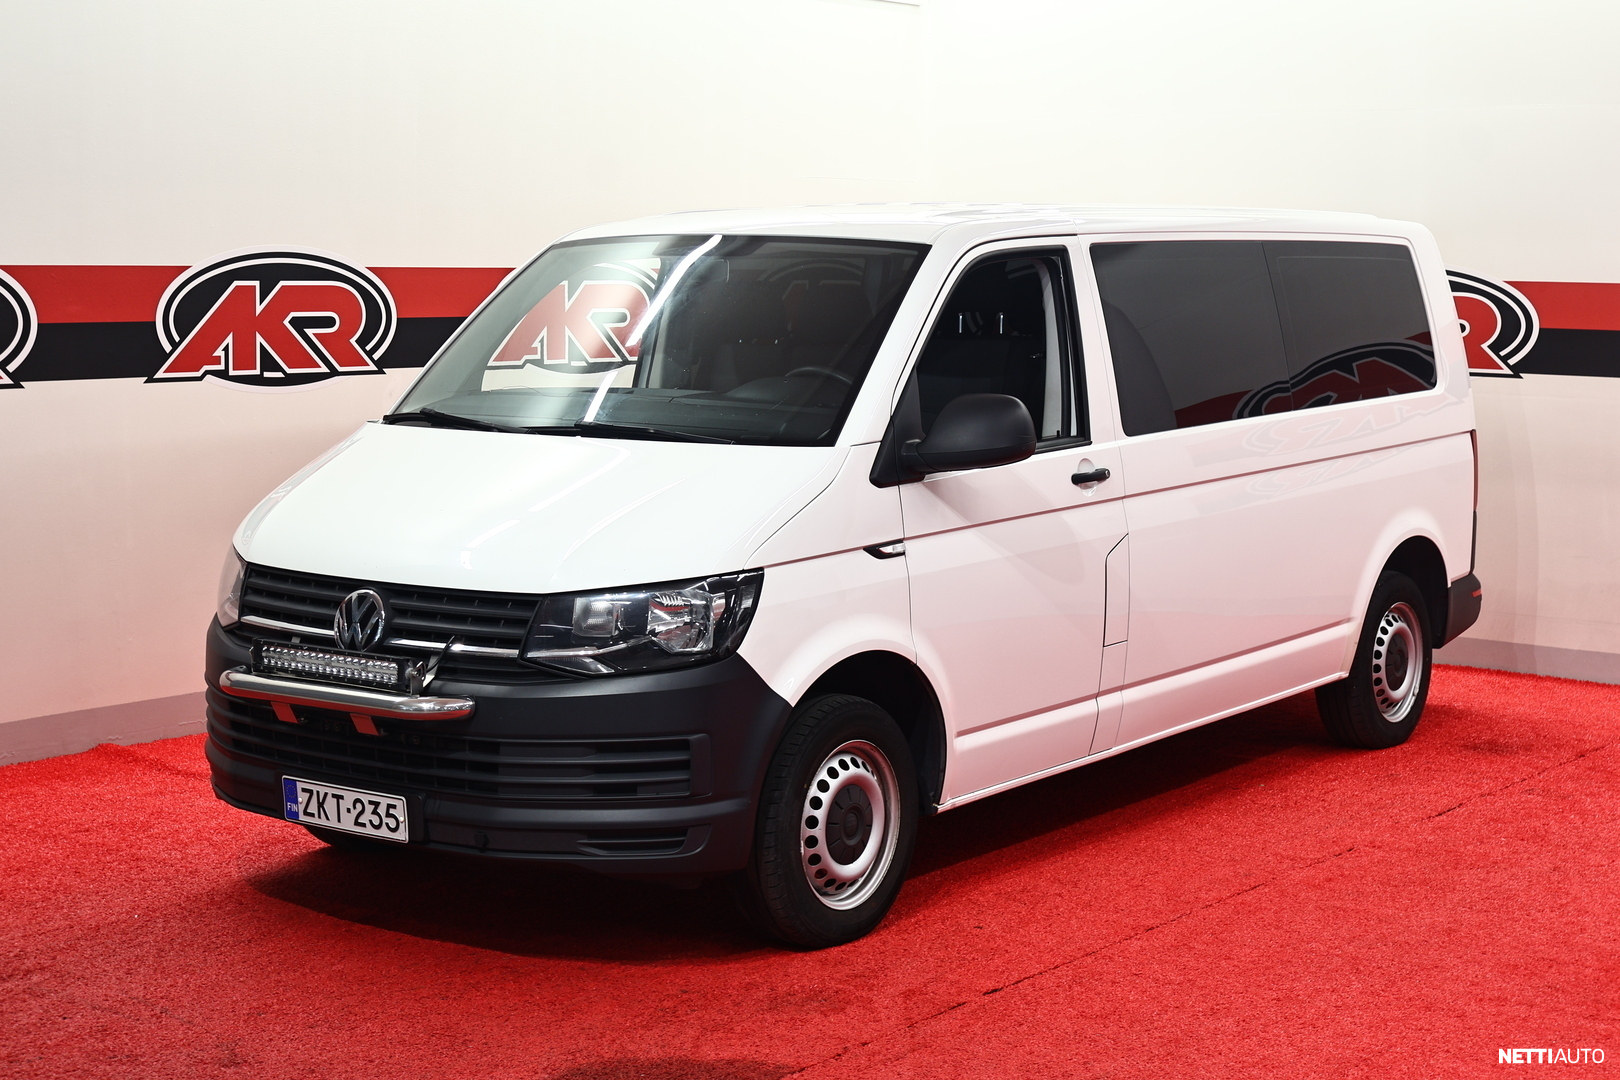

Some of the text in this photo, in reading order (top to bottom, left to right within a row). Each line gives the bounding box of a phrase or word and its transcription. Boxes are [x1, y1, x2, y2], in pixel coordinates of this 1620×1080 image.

[154, 280, 379, 378] AKR
[287, 802, 298, 812] FIN
[301, 787, 400, 833] ZKT-235
